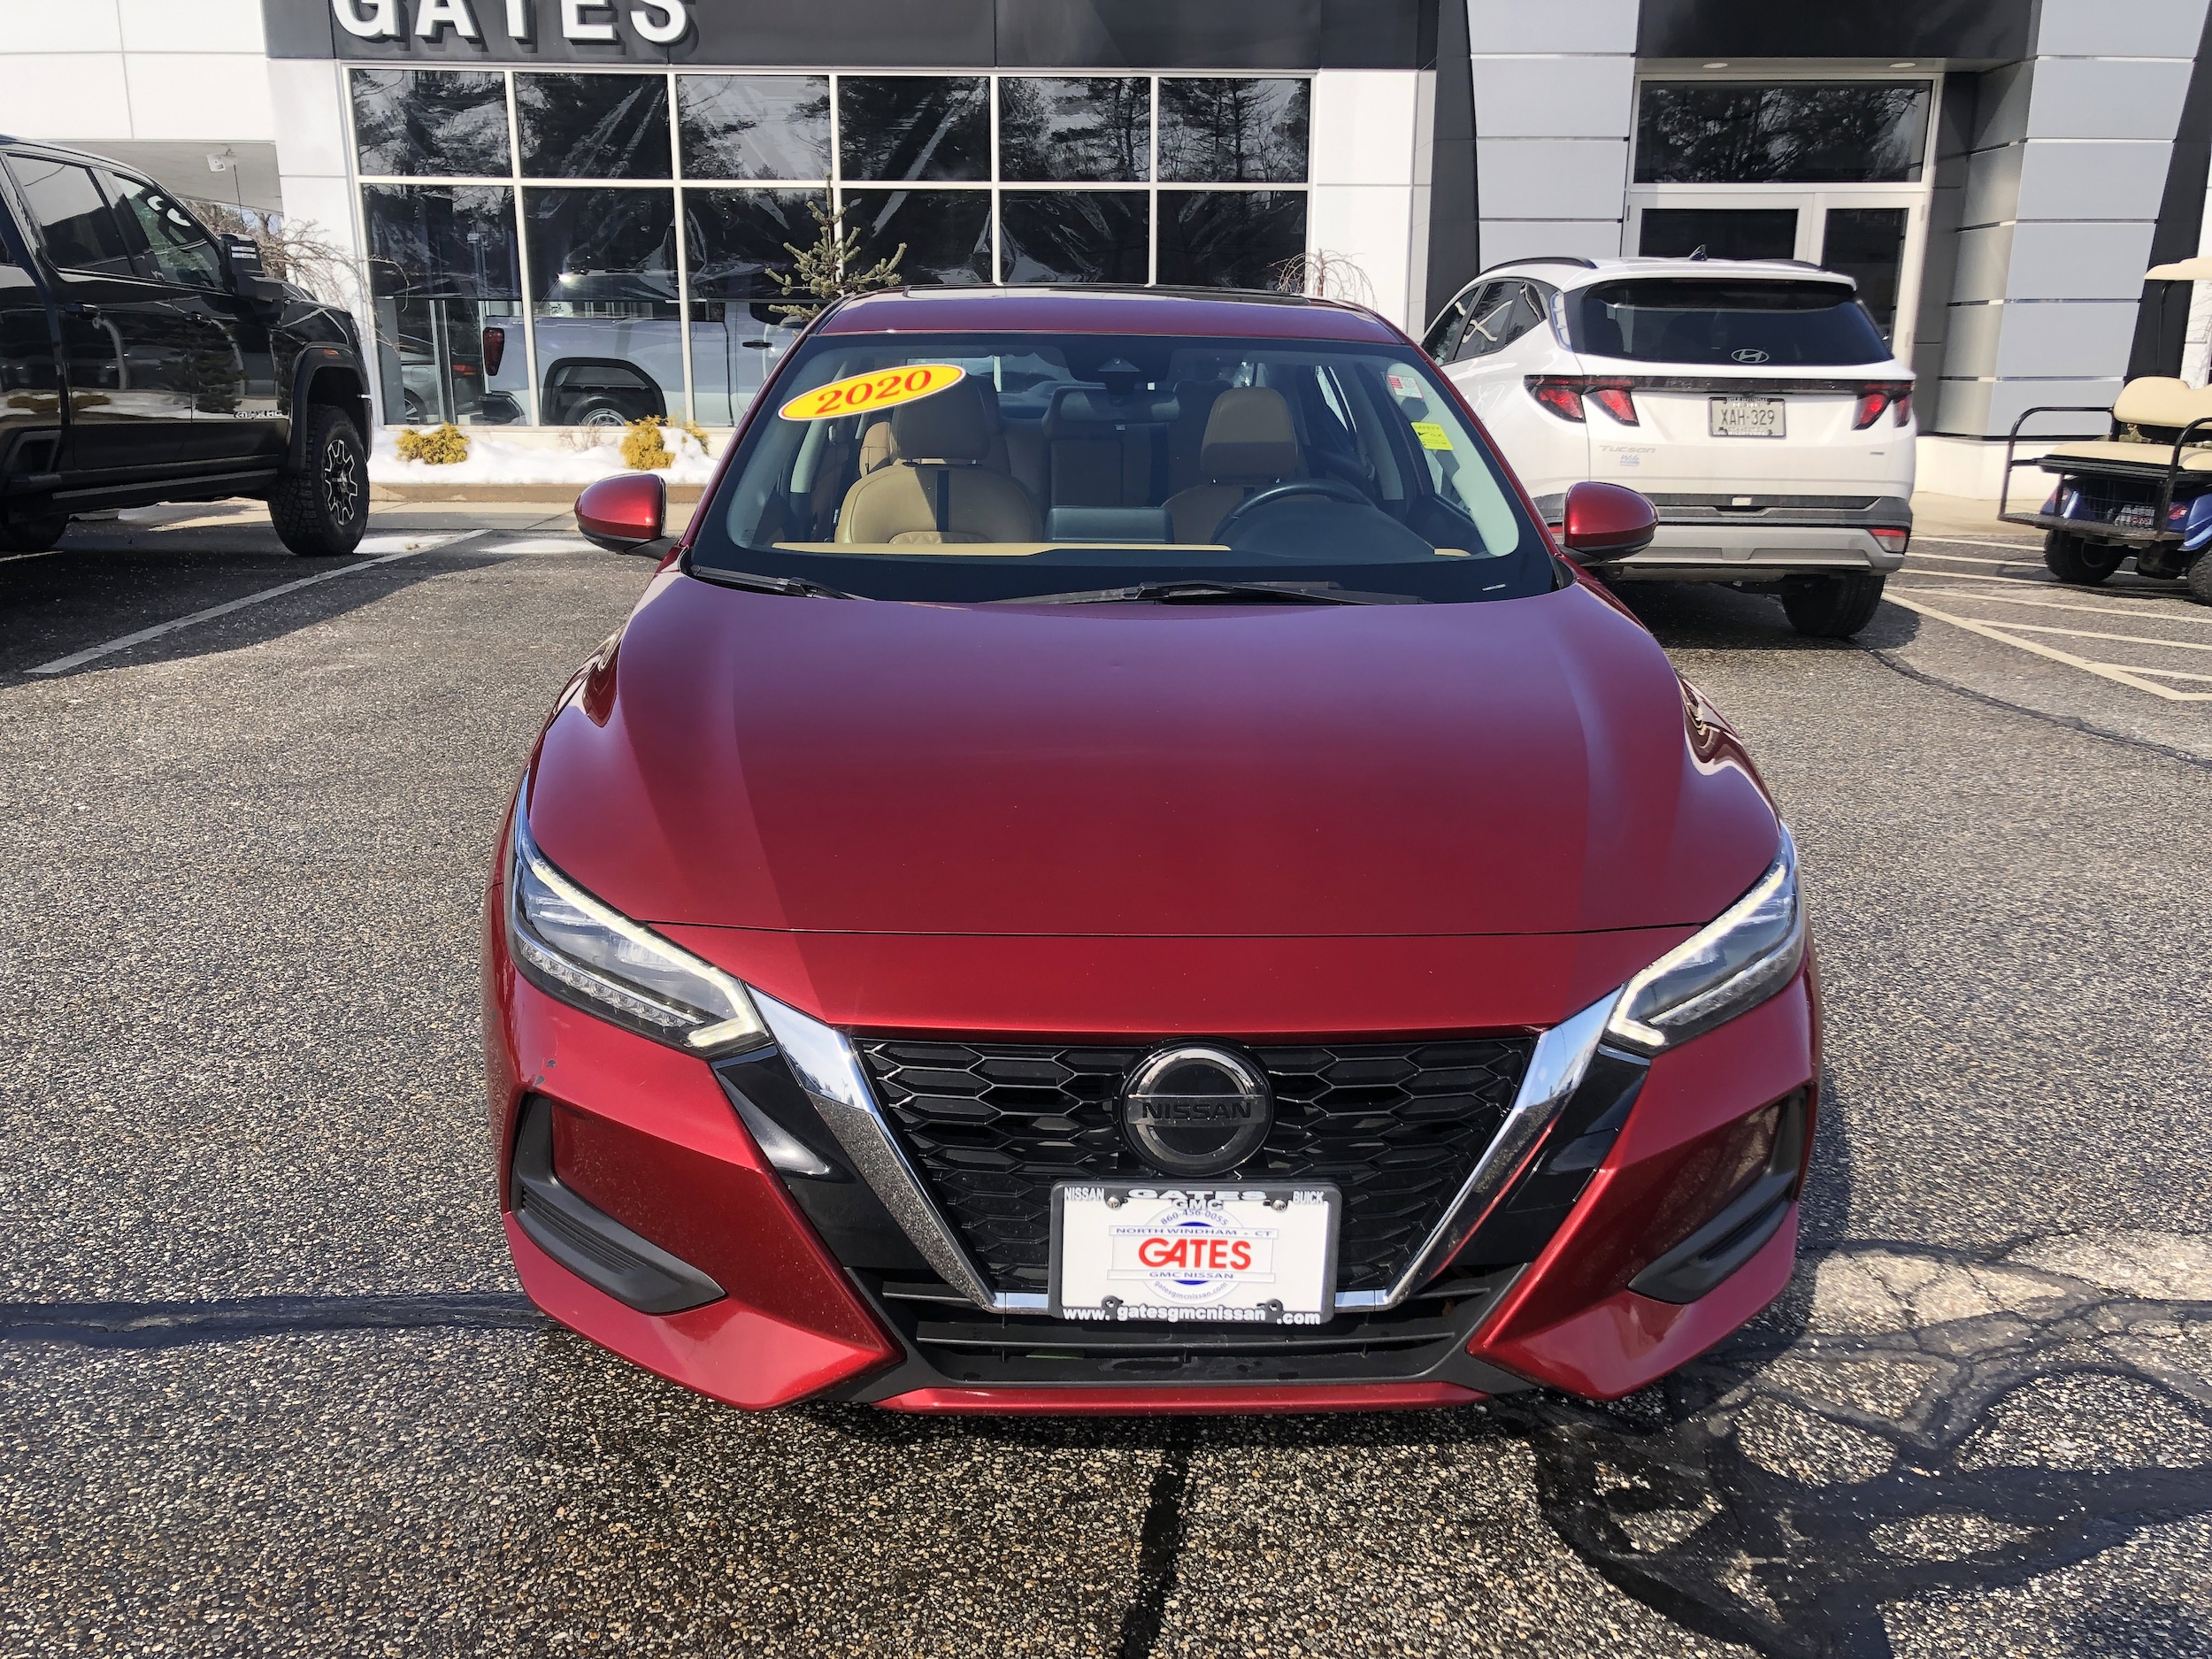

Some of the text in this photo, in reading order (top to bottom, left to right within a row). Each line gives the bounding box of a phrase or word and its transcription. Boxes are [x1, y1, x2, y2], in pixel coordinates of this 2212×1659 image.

[814, 370, 932, 415] 2020
[1142, 1102, 1252, 1119] NISSAN
[1064, 1187, 1105, 1202] NISSAN
[1127, 1188, 1267, 1201] GATES
[1292, 1190, 1325, 1205] BUICK
[1171, 1199, 1224, 1210] GMC
[1161, 1209, 1229, 1225] 860-456-0055
[1138, 1237, 1251, 1270] GATES
[1154, 1279, 1227, 1300] gatesgmcnissan.com
